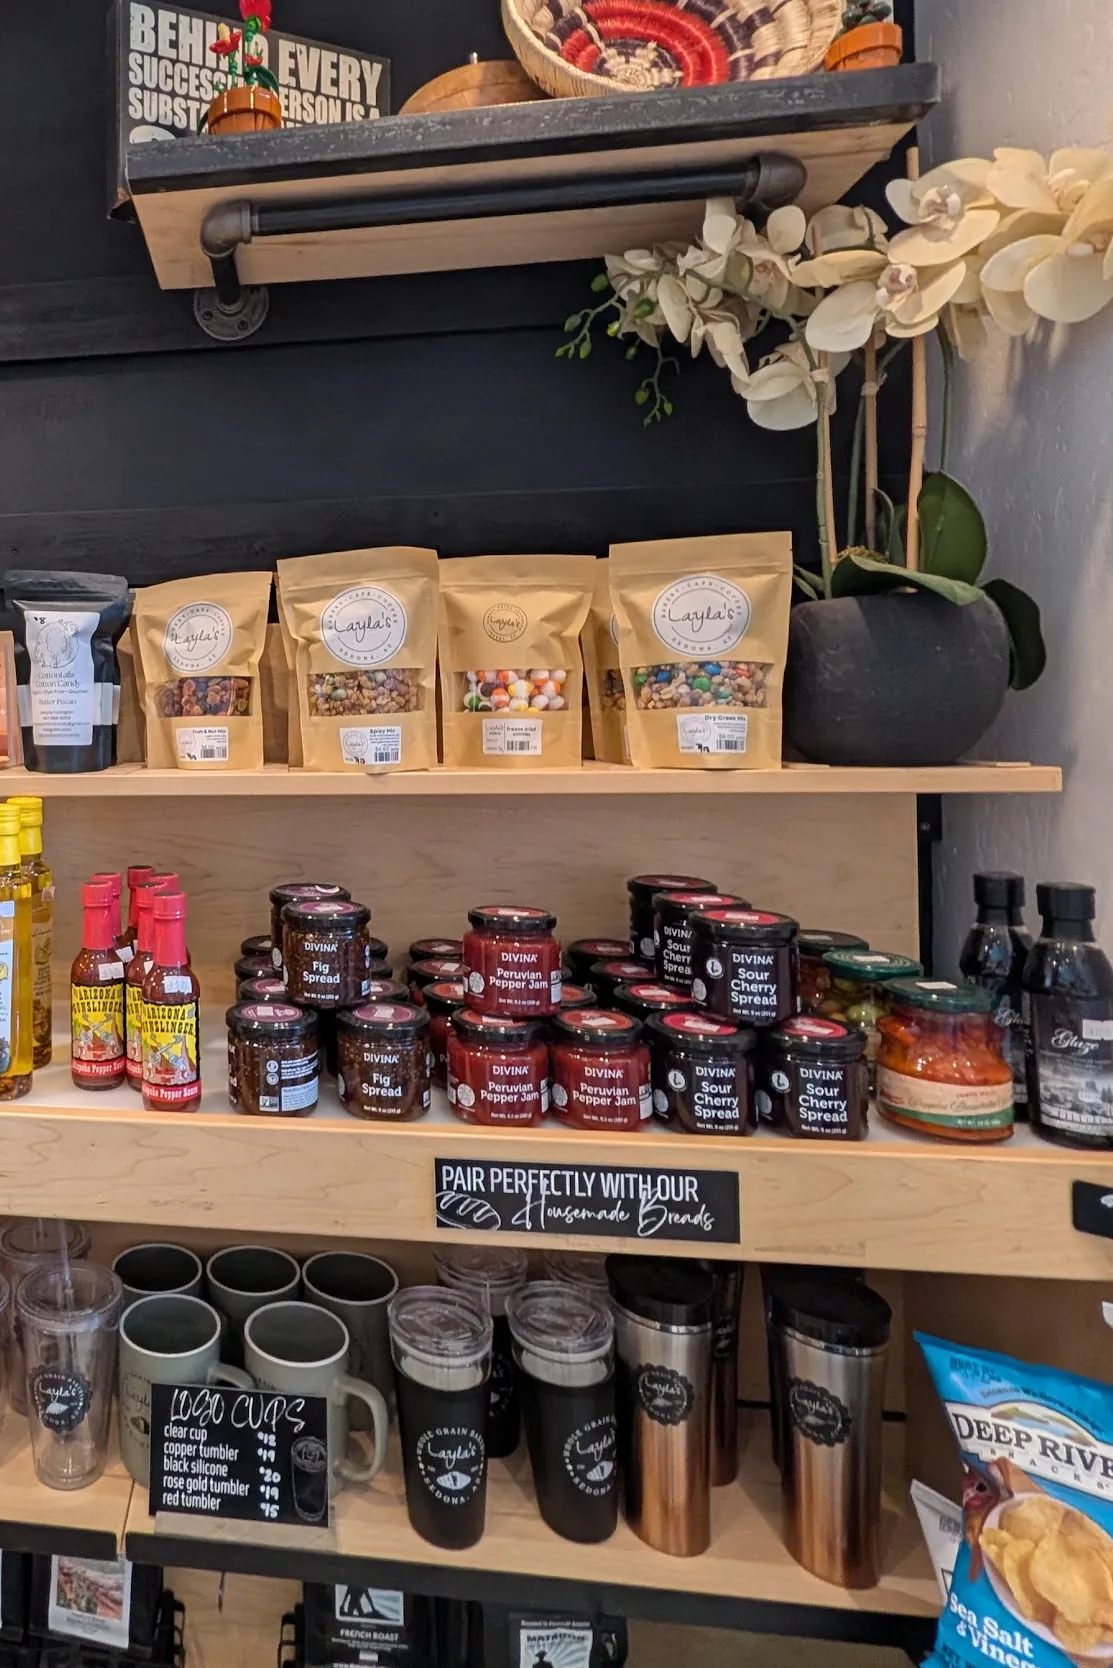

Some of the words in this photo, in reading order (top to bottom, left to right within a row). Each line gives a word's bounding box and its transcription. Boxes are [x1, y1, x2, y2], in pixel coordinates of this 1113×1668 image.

[278, 39, 383, 106] EVERY
[278, 87, 342, 125] ERSON
[668, 602, 735, 633] Layla's
[334, 611, 392, 643] Layla's
[174, 626, 220, 652] Layla's
[304, 941, 337, 952] DIVINA
[666, 939, 691, 952] Sour
[501, 952, 538, 963] DIVINA
[732, 952, 774, 965] DIVINA
[312, 961, 330, 973] Fig
[496, 968, 543, 980] Peruvian
[737, 967, 770, 981] Sour
[302, 971, 341, 985] Spread
[489, 976, 527, 990] Pepper
[528, 978, 549, 989] Jam
[78, 988, 116, 1001] ARIZONA
[730, 979, 777, 995] Cherry
[730, 991, 777, 1006] Spread
[146, 1007, 187, 1020] ARIZONA
[1051, 1027, 1099, 1055] Glaze
[363, 1052, 400, 1064] DIVINA
[91, 1063, 112, 1075] Pepper
[492, 1065, 529, 1076] DIVINA
[584, 1066, 624, 1079] DIVINA
[695, 1065, 735, 1078] DIVINA
[799, 1067, 843, 1081] DIVINA
[372, 1072, 391, 1087] Fig
[160, 1086, 183, 1100] Pepper
[183, 1085, 199, 1098] Sauce
[361, 1083, 403, 1098] Spread
[487, 1081, 534, 1094] Peruvian
[580, 1082, 630, 1096] Peruvian
[701, 1081, 733, 1094] Sour
[805, 1082, 840, 1096] Sour
[480, 1088, 519, 1105] Pepper
[520, 1089, 540, 1101] Jam
[572, 1090, 613, 1107] Pepper
[614, 1093, 637, 1107] Jam
[694, 1094, 739, 1109] Cherry
[798, 1094, 847, 1110] Cherry
[694, 1105, 740, 1120] Spread
[798, 1106, 848, 1123] Spread
[442, 1165, 485, 1192] PAIR
[490, 1167, 595, 1199] PERFECTLY
[600, 1171, 653, 1200] WITH
[656, 1174, 699, 1203] OUR
[512, 1177, 630, 1230] Housemade
[637, 1186, 715, 1237] Breads
[38, 1384, 77, 1404] Layla's
[170, 1388, 225, 1427] LOGO
[230, 1394, 306, 1433] CUPS
[163, 1422, 188, 1438] clear
[189, 1427, 208, 1445] cup
[257, 1431, 277, 1447] $12
[435, 1426, 468, 1437] GRAIN
[952, 1412, 1033, 1451] DEEP
[163, 1441, 199, 1458] copper
[199, 1444, 239, 1461] tumbler
[575, 1427, 616, 1462] Layla's
[427, 1440, 477, 1471] Layla's
[163, 1456, 189, 1473] black
[191, 1462, 229, 1477] silicone
[259, 1466, 281, 1483] $20
[163, 1475, 185, 1490] rose
[186, 1477, 208, 1494] gold
[209, 1480, 250, 1497] tumbler
[163, 1490, 180, 1506] red
[181, 1494, 221, 1511] tumbler
[949, 1591, 978, 1629] Sea
[983, 1615, 1035, 1659] Salt
[956, 1619, 968, 1638] &
[339, 1628, 372, 1640] FRENCH
[372, 1631, 400, 1642] ROAST
